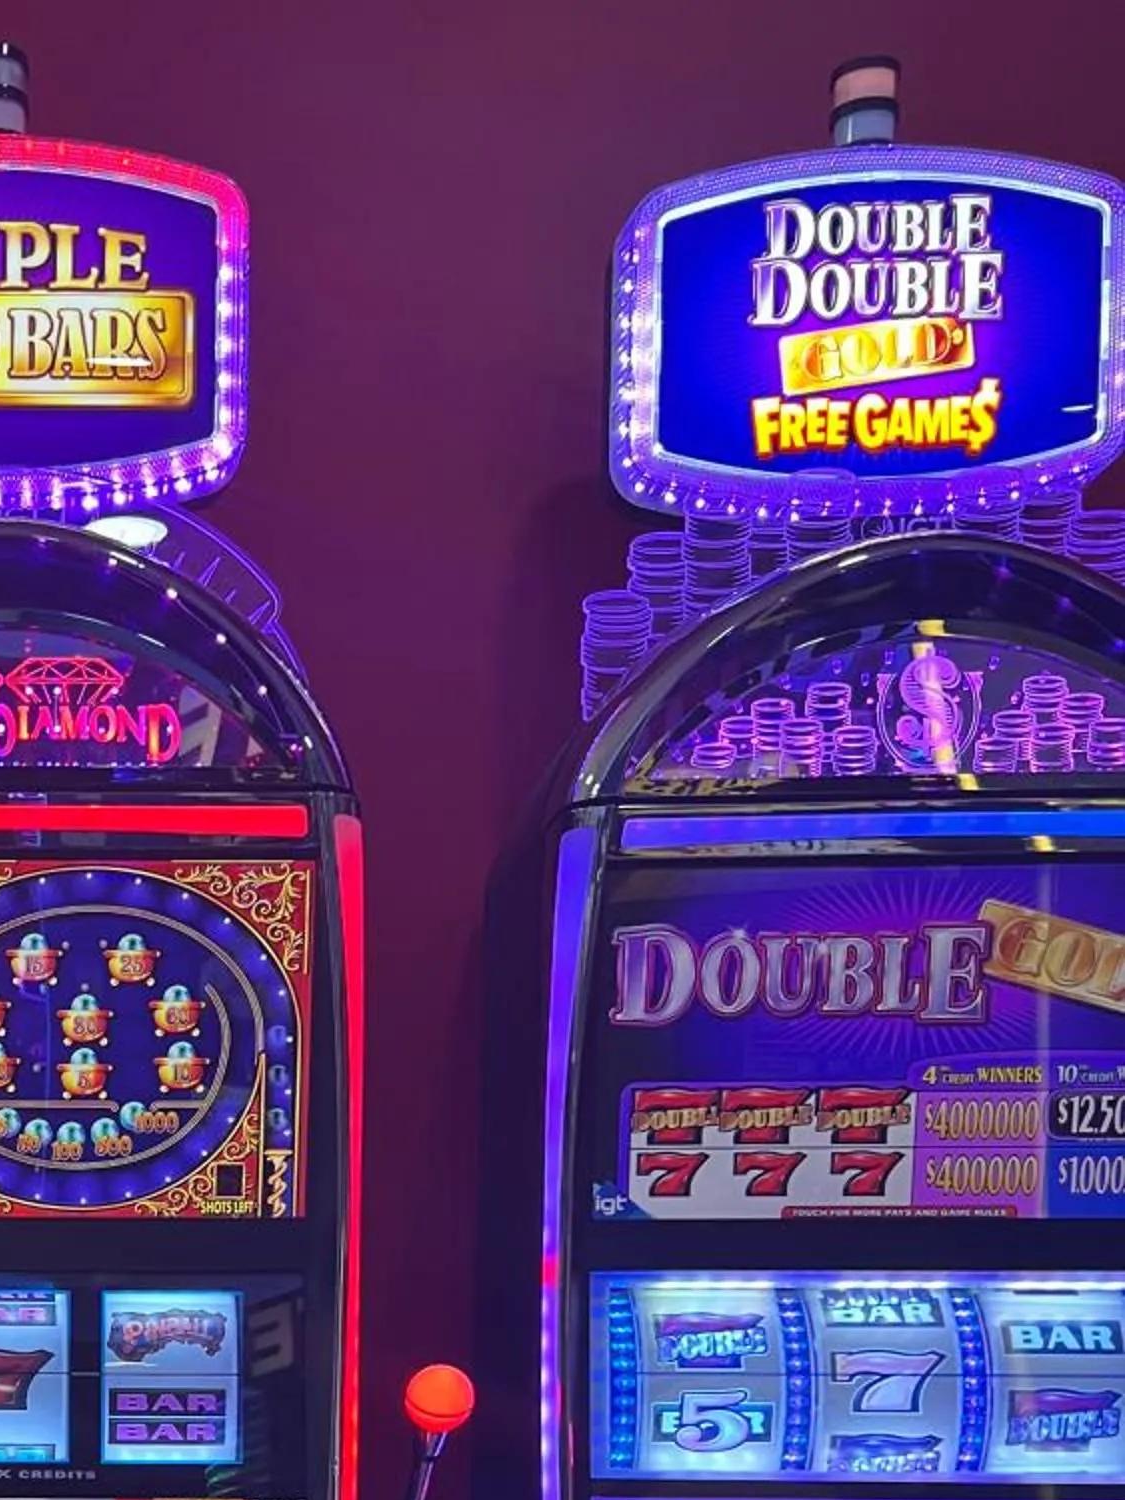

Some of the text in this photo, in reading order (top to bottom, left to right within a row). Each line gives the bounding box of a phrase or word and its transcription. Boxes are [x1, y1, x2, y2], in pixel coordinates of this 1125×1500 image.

[764, 194, 991, 259] DOUBLE
[748, 253, 1003, 327] DOUBLE
[8, 306, 168, 381] BARS
[800, 321, 957, 383] GOLD
[751, 395, 852, 459] FREE
[611, 924, 987, 1026] DOUBLE
[976, 1065, 1043, 1083] WINNERS
[636, 1151, 710, 1197] 7
[732, 1151, 808, 1197] 7
[830, 1151, 906, 1197] 7
[200, 1200, 232, 1214] SHOTS
[594, 1195, 628, 1216] igt
[830, 1302, 937, 1323] BAR
[1008, 1324, 1116, 1350] BAR
[116, 1393, 217, 1412] BAR
[830, 1349, 947, 1413] 7
[116, 1423, 217, 1441] BAR
[676, 1388, 750, 1452] 5
[17, 1469, 97, 1481] CREDITS
